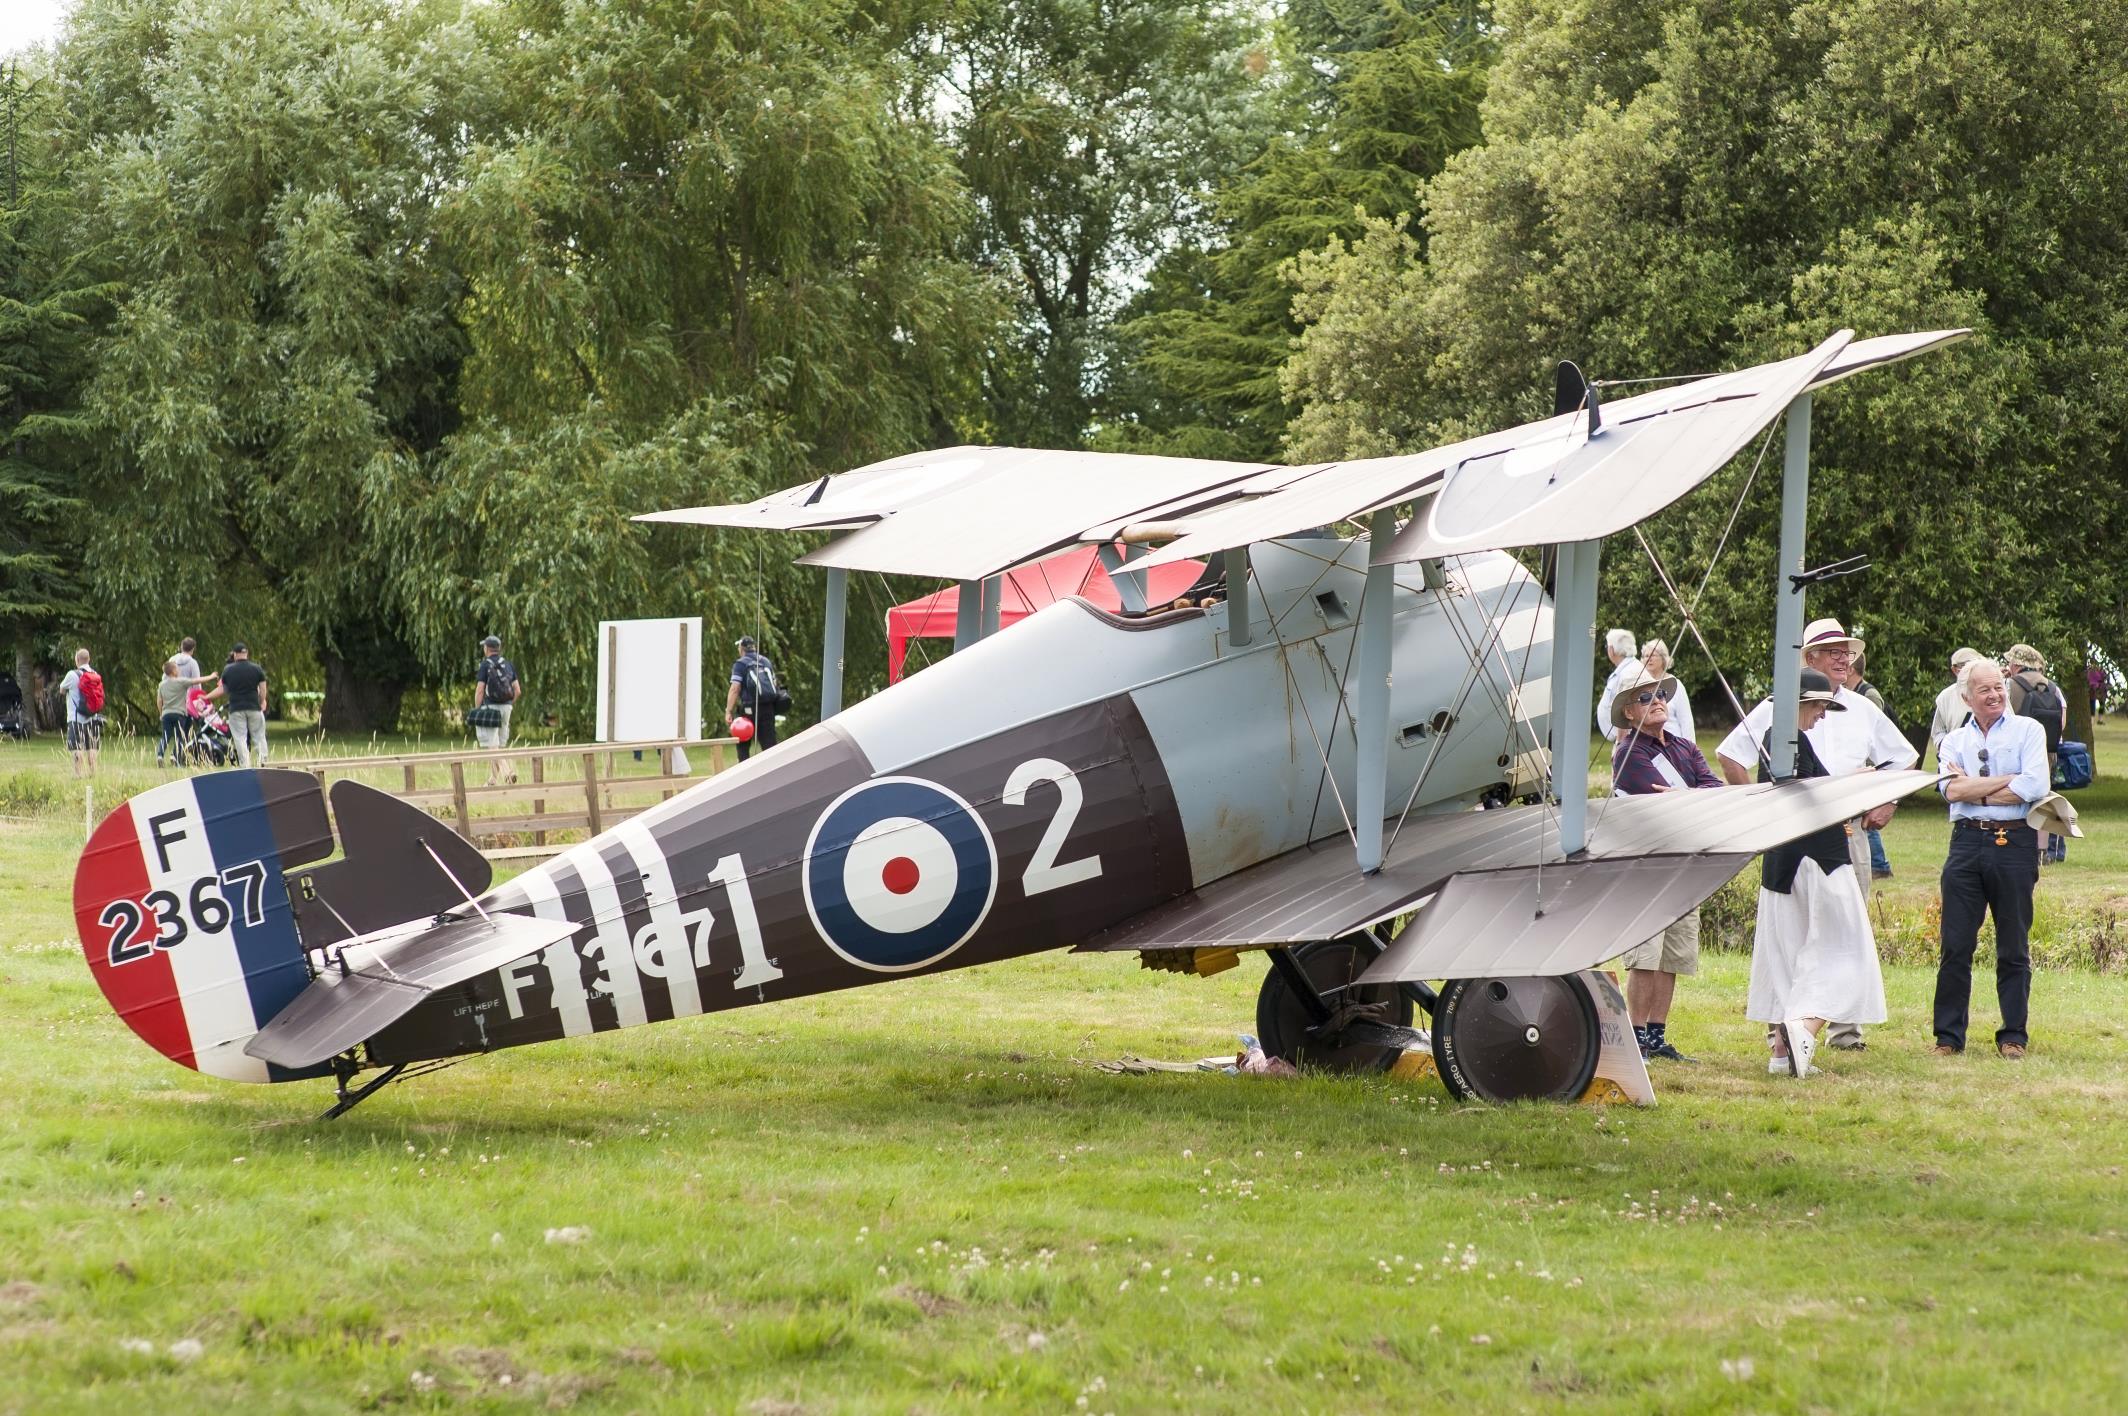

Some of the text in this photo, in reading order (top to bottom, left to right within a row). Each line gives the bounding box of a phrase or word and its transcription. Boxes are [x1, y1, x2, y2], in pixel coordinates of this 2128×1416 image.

[148, 808, 187, 874] F
[1002, 757, 1103, 897] 2
[98, 859, 267, 968] 2367
[707, 852, 784, 990] 1
[453, 999, 500, 1017] LIFT HERE
[1444, 1035, 1455, 1062] TYRE
[1451, 1064, 1468, 1089] AERO
